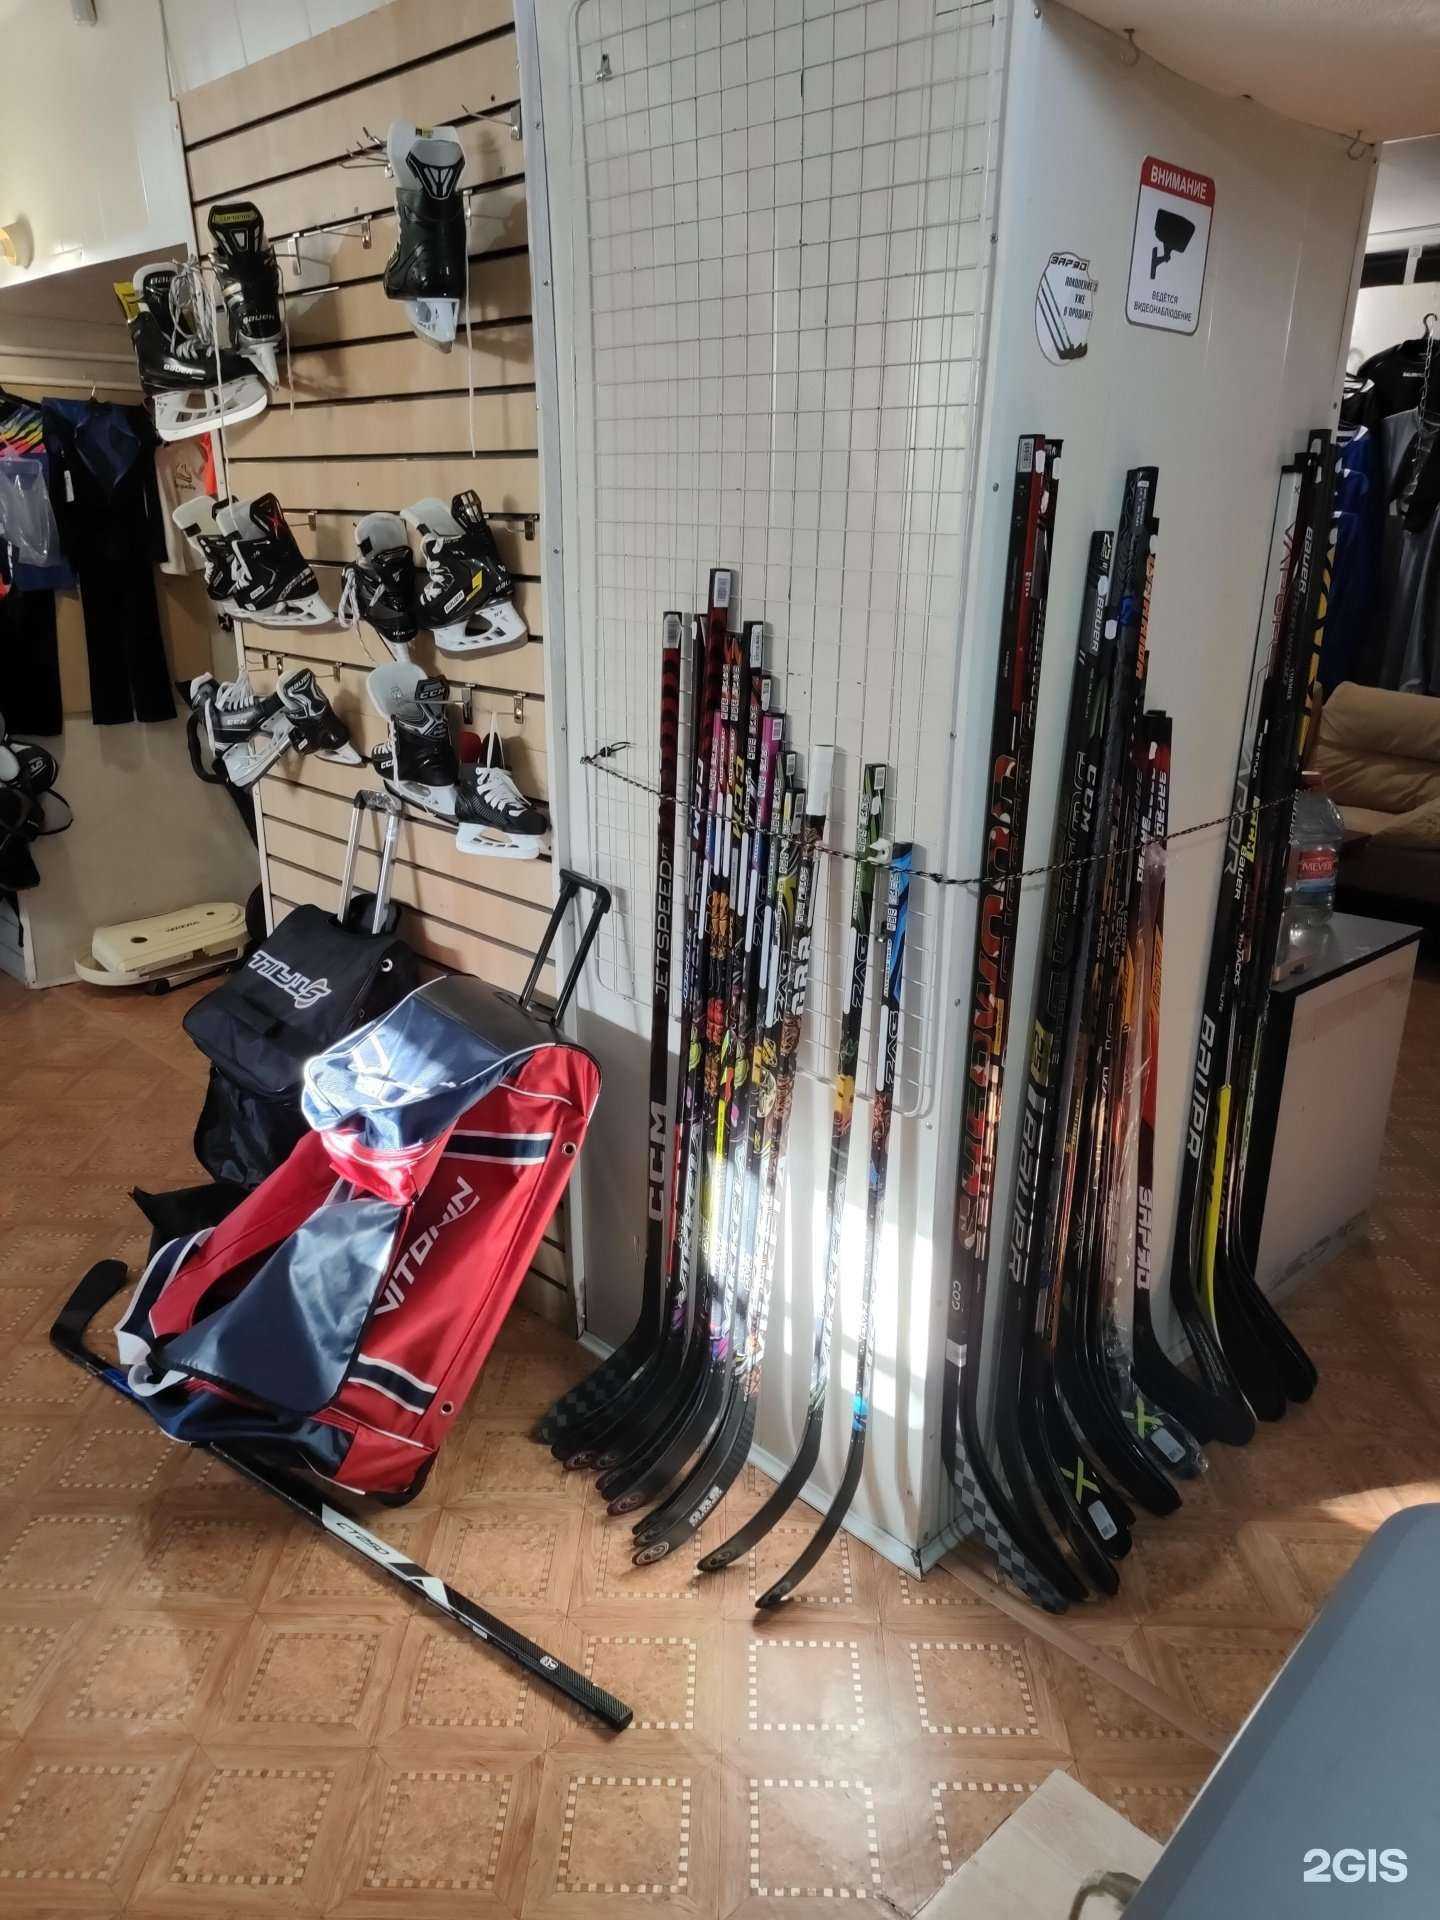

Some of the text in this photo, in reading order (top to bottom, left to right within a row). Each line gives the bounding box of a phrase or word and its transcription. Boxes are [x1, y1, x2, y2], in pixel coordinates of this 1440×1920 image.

[1150, 165, 1207, 200] ВНИМАНИЕ
[1133, 300, 1193, 322] ВИДЕОНАБЛЮДЕНИЕ
[1091, 596, 1105, 652] BAUER
[419, 688, 446, 700] CCM
[1080, 763, 1097, 832] CCM
[655, 860, 673, 1002] JETSPEED
[852, 934, 868, 1010] ZAG
[886, 1010, 900, 1085] ZAG
[1187, 1013, 1216, 1160] BAUER
[649, 1101, 667, 1222] CCM
[1009, 1108, 1036, 1283] BAUER
